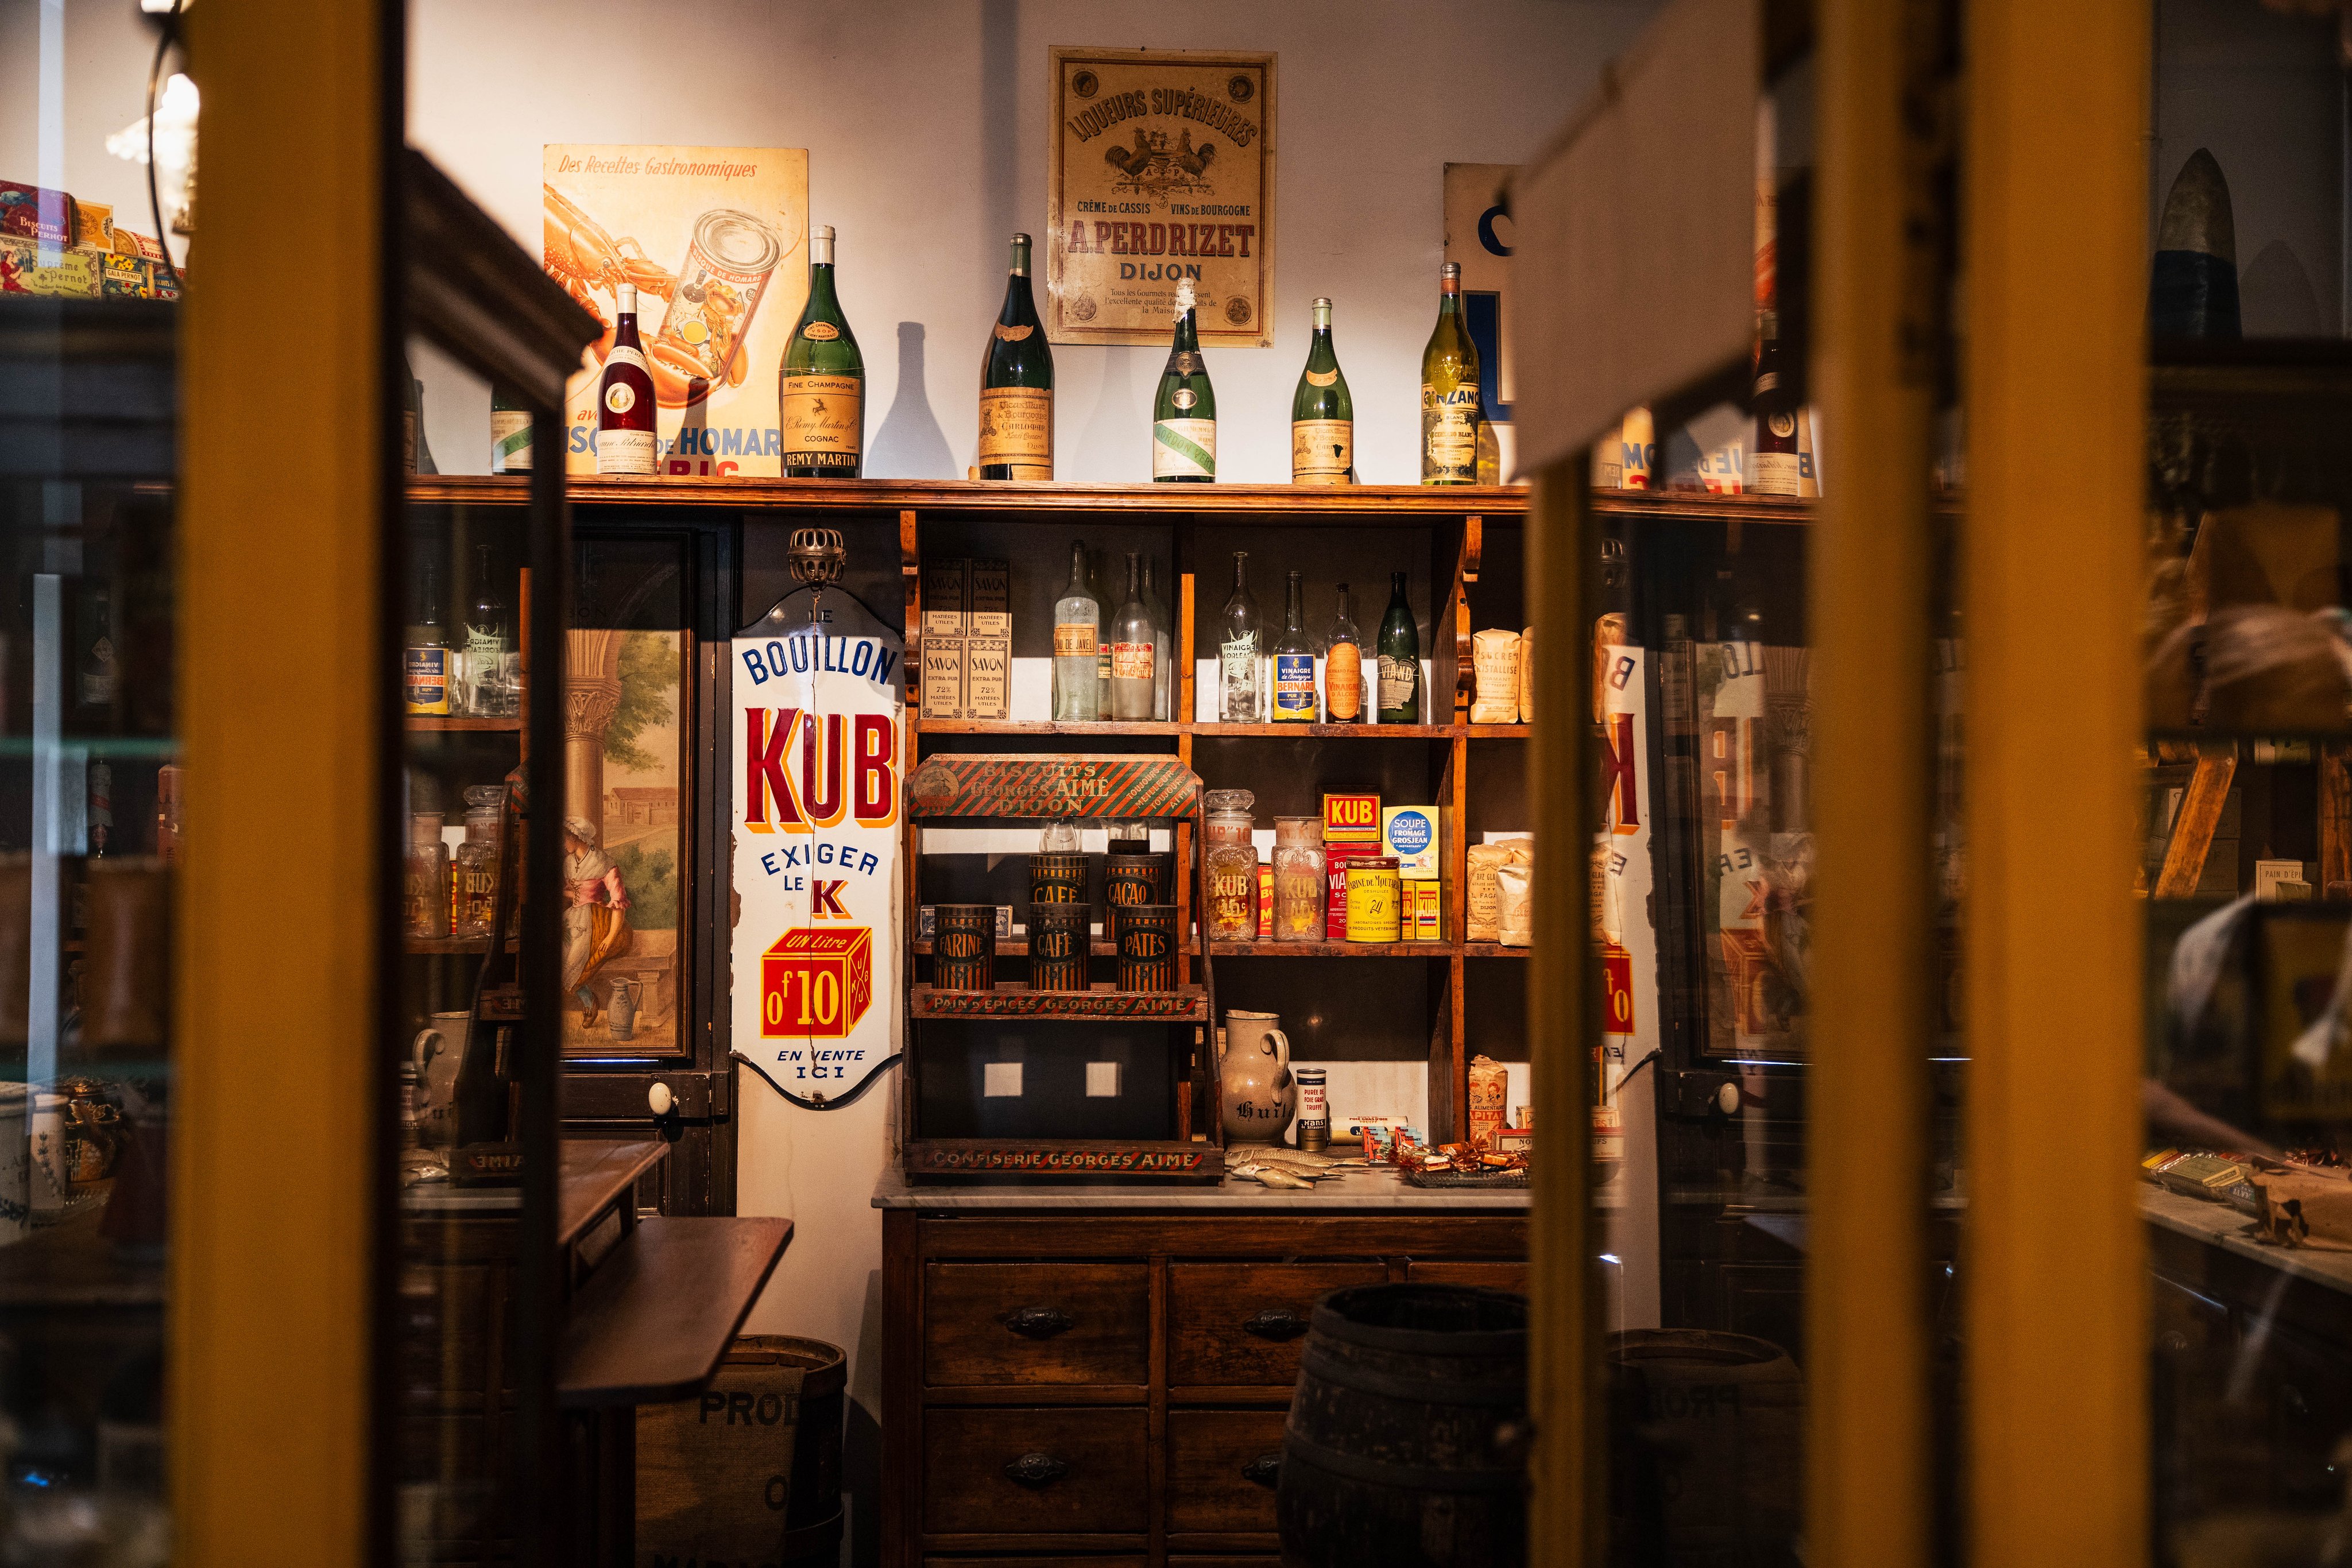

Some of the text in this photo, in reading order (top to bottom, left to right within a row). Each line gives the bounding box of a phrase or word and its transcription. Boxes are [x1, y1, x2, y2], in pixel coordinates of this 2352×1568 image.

[1067, 90, 1147, 142] LIQUEURS
[1151, 86, 1258, 147] SUPÉRIEURES
[558, 155, 757, 181] Des Recettes Gastronomiques
[1108, 205, 1117, 213] DE
[1119, 202, 1151, 214] CASSIS
[1171, 203, 1190, 215] VINS
[1201, 204, 1251, 216] BOURGOGNE
[693, 249, 762, 283] BISQUE DE HOMARD
[1120, 262, 1202, 281] DIJON
[107, 269, 141, 281] GALA PERNOT
[1111, 288, 1125, 296] Tous
[1137, 289, 1166, 297] Gourmets
[1105, 297, 1143, 305] l'excellente
[1144, 297, 1166, 307] qualité
[788, 381, 854, 390] FINE CHAMPAGNE
[680, 427, 782, 457] HOMAR
[787, 452, 856, 467] REMY MARTIN
[975, 577, 1005, 591] SAVON
[808, 610, 833, 624] LE
[1065, 638, 1073, 649] DE
[1076, 638, 1092, 649] JAVEL
[742, 634, 898, 686] BOUILLON
[927, 657, 959, 671] SAVON
[1481, 652, 1512, 661] SUCRE
[972, 657, 1003, 672] SAVON
[1474, 664, 1517, 675] CRISTALLISÉ
[1382, 664, 1413, 681] VIAND
[1278, 682, 1314, 691] BERNARD
[1329, 682, 1360, 691] VINAIGRE
[744, 707, 898, 834] KUB
[984, 765, 1096, 777] BISCUITS
[971, 776, 1110, 797] GEORGES AIMÉ
[1126, 767, 1160, 800] TOUJOURS
[1135, 769, 1175, 810] MEILLEUR
[1151, 775, 1187, 810] TOUJOURS
[998, 799, 1084, 812] DIJON
[1332, 800, 1373, 824] KUB
[1394, 819, 1426, 828] SOUPE
[761, 843, 879, 876] EXIGER
[2265, 870, 2280, 878] PAIN
[1215, 876, 1247, 896] KUB
[1348, 878, 1364, 892] FARINE
[784, 875, 853, 920] LE K
[1034, 886, 1078, 903] CAFÉ
[1108, 882, 1147, 905] CACAO
[1419, 899, 1436, 917] KUB
[786, 935, 847, 948] UN Litre
[939, 933, 983, 958] FARINE
[1036, 931, 1073, 958] CAFÉ
[1125, 931, 1166, 957] PÂTES
[934, 997, 968, 1009] PAIN
[1046, 997, 1127, 1011] GEORGES
[777, 1050, 865, 1061] EN VENTE
[796, 1066, 844, 1079] ICI
[933, 1152, 1041, 1166] CONFISERIE
[1048, 1152, 1134, 1167] GEORGES
